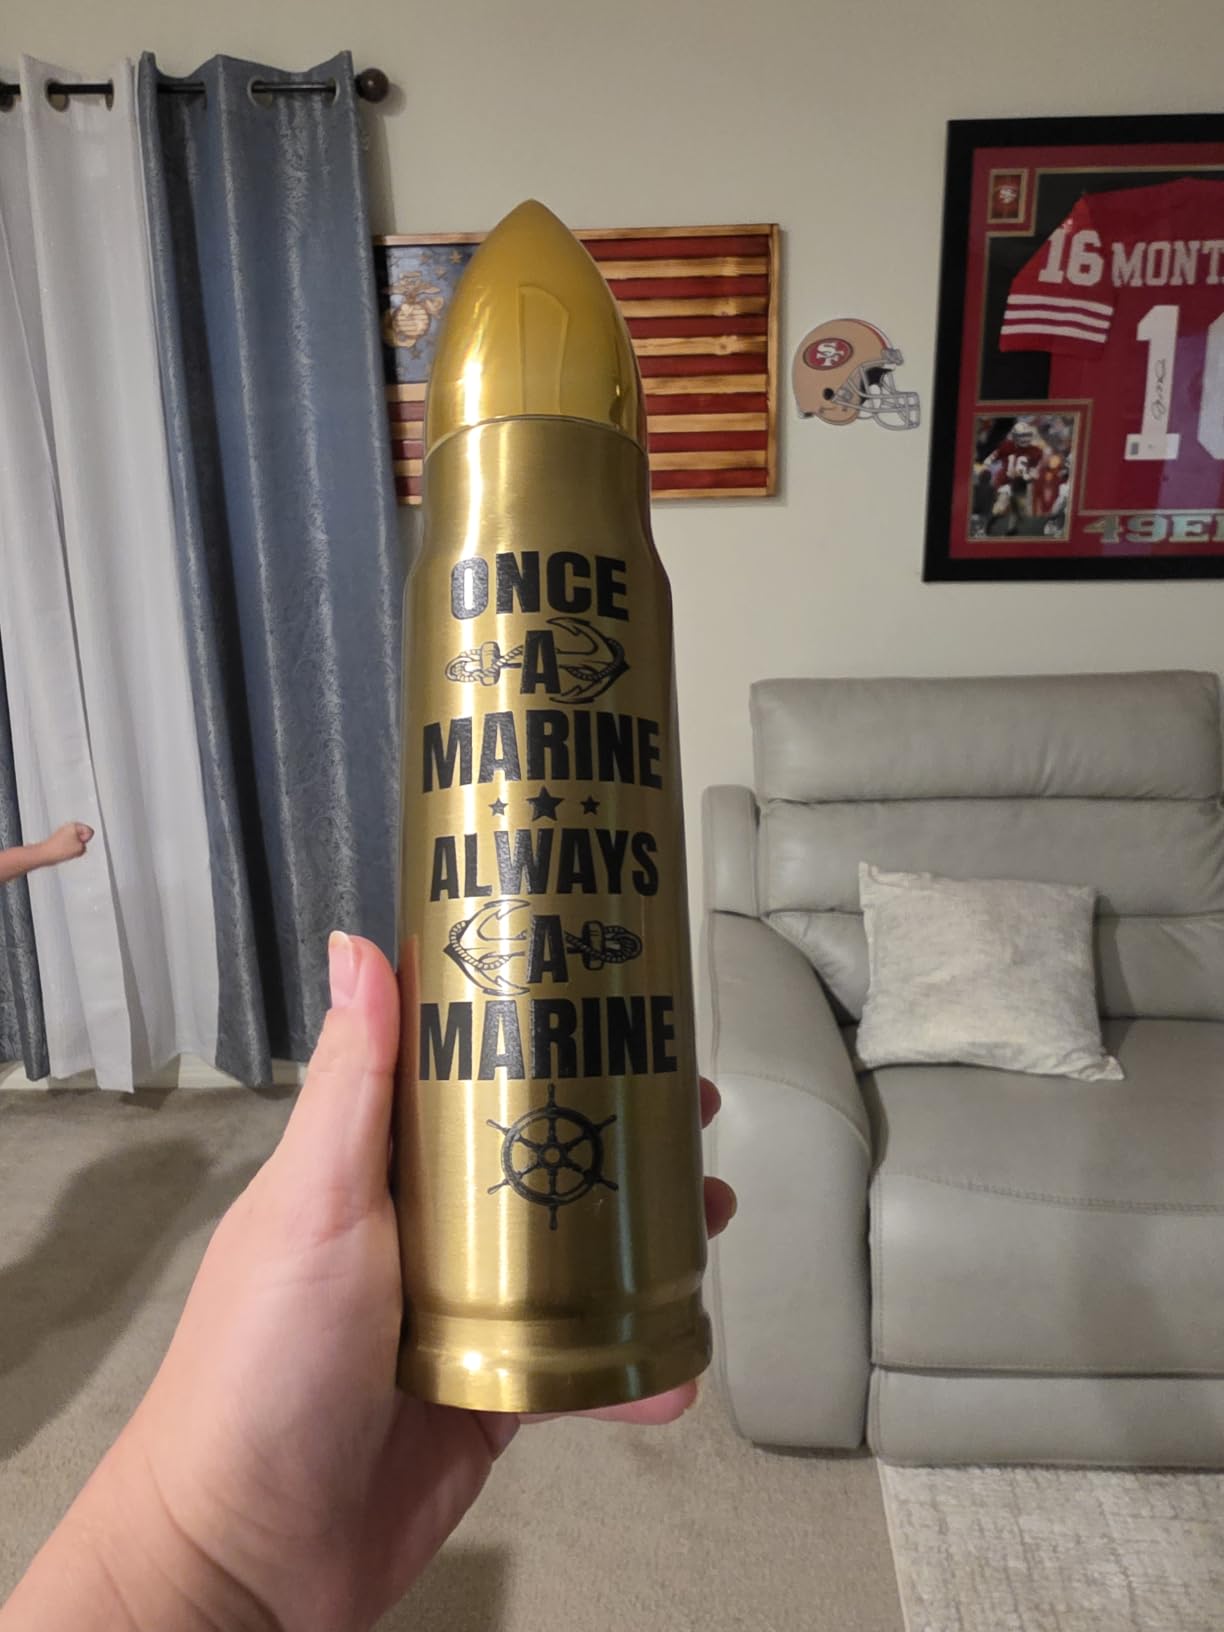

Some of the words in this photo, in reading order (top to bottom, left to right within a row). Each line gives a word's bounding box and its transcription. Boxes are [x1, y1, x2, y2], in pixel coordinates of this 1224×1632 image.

[1038, 219, 1104, 286] 16
[1111, 239, 1224, 287] MONT
[451, 551, 630, 621] ONCE
[520, 630, 561, 694] A
[423, 709, 663, 793] MARINE
[430, 828, 659, 902] ALWAYS
[527, 915, 569, 984] A
[419, 995, 678, 1081] MARINE
